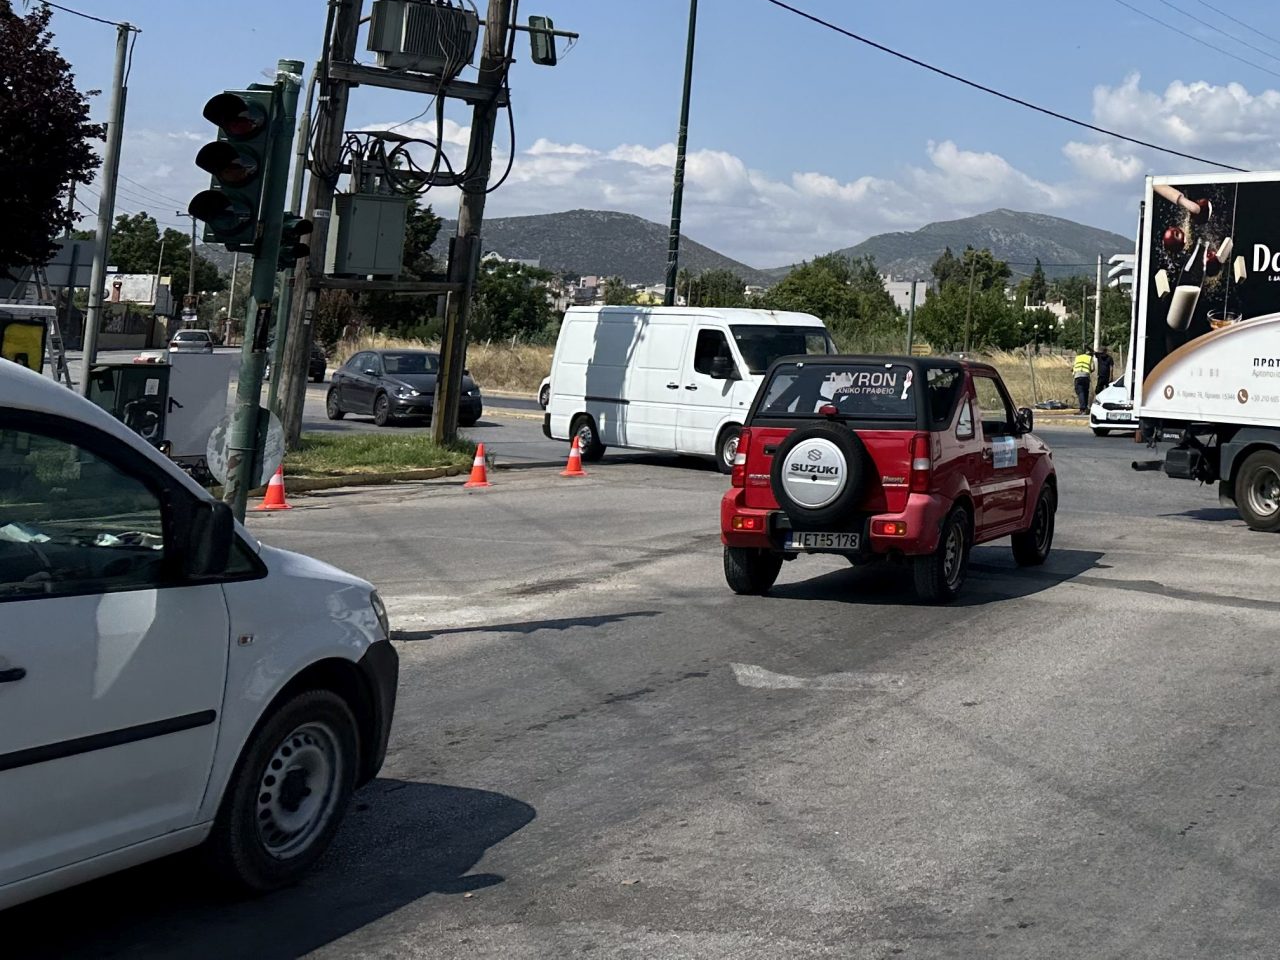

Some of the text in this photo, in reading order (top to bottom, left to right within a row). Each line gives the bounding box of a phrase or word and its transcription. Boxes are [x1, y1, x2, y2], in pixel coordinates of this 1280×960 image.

[830, 372, 897, 387] MYRON
[861, 387, 895, 395] ΓΡΑΦΕΙΟ
[790, 463, 839, 475] SUZUKI
